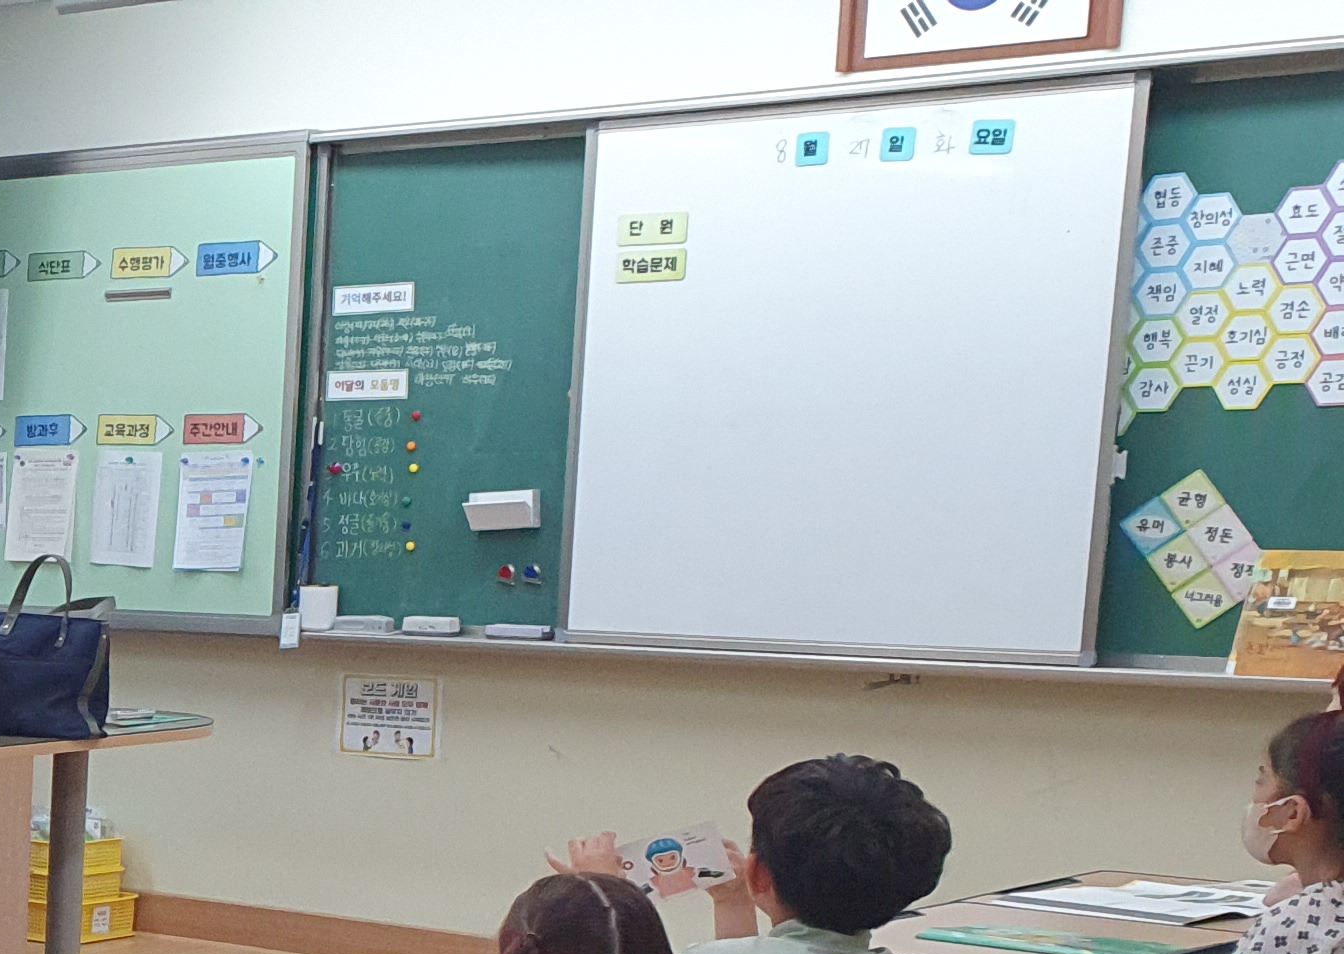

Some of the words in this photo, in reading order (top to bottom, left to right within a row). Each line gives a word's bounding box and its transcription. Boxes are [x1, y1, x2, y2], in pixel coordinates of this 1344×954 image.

[803, 138, 818, 158] 월
[888, 136, 905, 154] 일
[973, 128, 1008, 146] 요일
[1154, 186, 1183, 209] 협동
[1190, 207, 1233, 229] 창의성
[1288, 204, 1320, 219] 효도
[629, 220, 644, 237] 단
[659, 218, 674, 236] 원
[1149, 234, 1180, 256] 존중
[38, 258, 71, 275] 식단표
[117, 255, 165, 272] 수행평가
[202, 252, 252, 270] 월중행사
[622, 255, 678, 274] 학습문제
[1193, 258, 1224, 274] 지혜
[1285, 251, 1315, 270] 근면
[1147, 283, 1177, 302] 책임
[1236, 277, 1267, 297] 노력
[340, 290, 407, 306] 기억해주세요!
[1189, 304, 1219, 326] 열정
[1279, 299, 1311, 320] 겸손
[1143, 328, 1172, 351] 행복
[1225, 326, 1268, 346] 호기심
[1184, 353, 1214, 372] 끈기
[1274, 350, 1306, 370] 긍정
[334, 378, 365, 393] 이달의
[1139, 379, 1169, 396] 감사
[1227, 375, 1257, 396] 성실
[26, 423, 59, 439] 방과후
[104, 423, 151, 439] 교육과정
[189, 422, 239, 438] 주간안내
[1177, 491, 1208, 510] 균형
[1136, 518, 1165, 534] 유머
[1204, 525, 1233, 545] 정돈
[1163, 552, 1193, 570] 봉사
[1184, 590, 1224, 608] 너그러움
